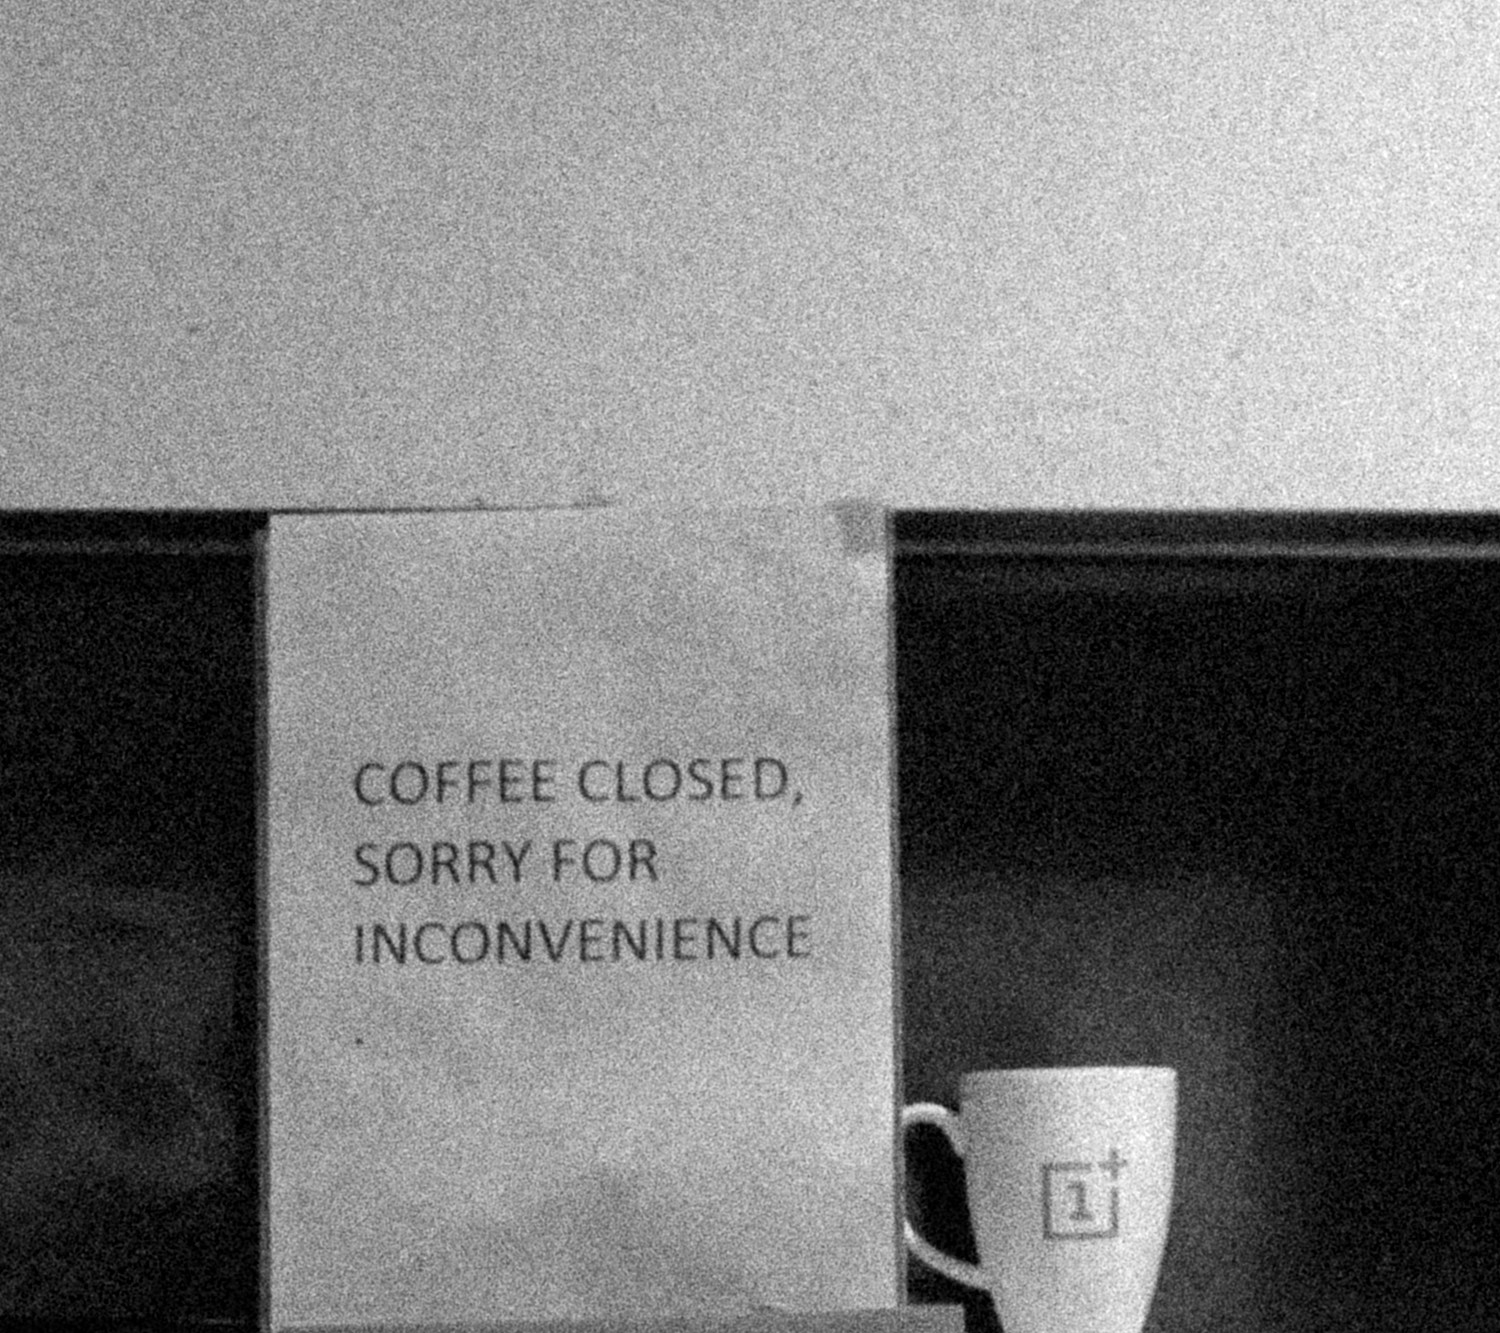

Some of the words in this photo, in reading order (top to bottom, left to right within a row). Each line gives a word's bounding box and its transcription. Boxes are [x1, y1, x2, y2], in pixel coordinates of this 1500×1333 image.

[353, 760, 556, 807] COFFEE
[578, 757, 805, 808] CLOSED,
[353, 840, 531, 886] SORRY
[552, 838, 660, 883] FOR
[353, 915, 812, 966] INCONVENIENCE
